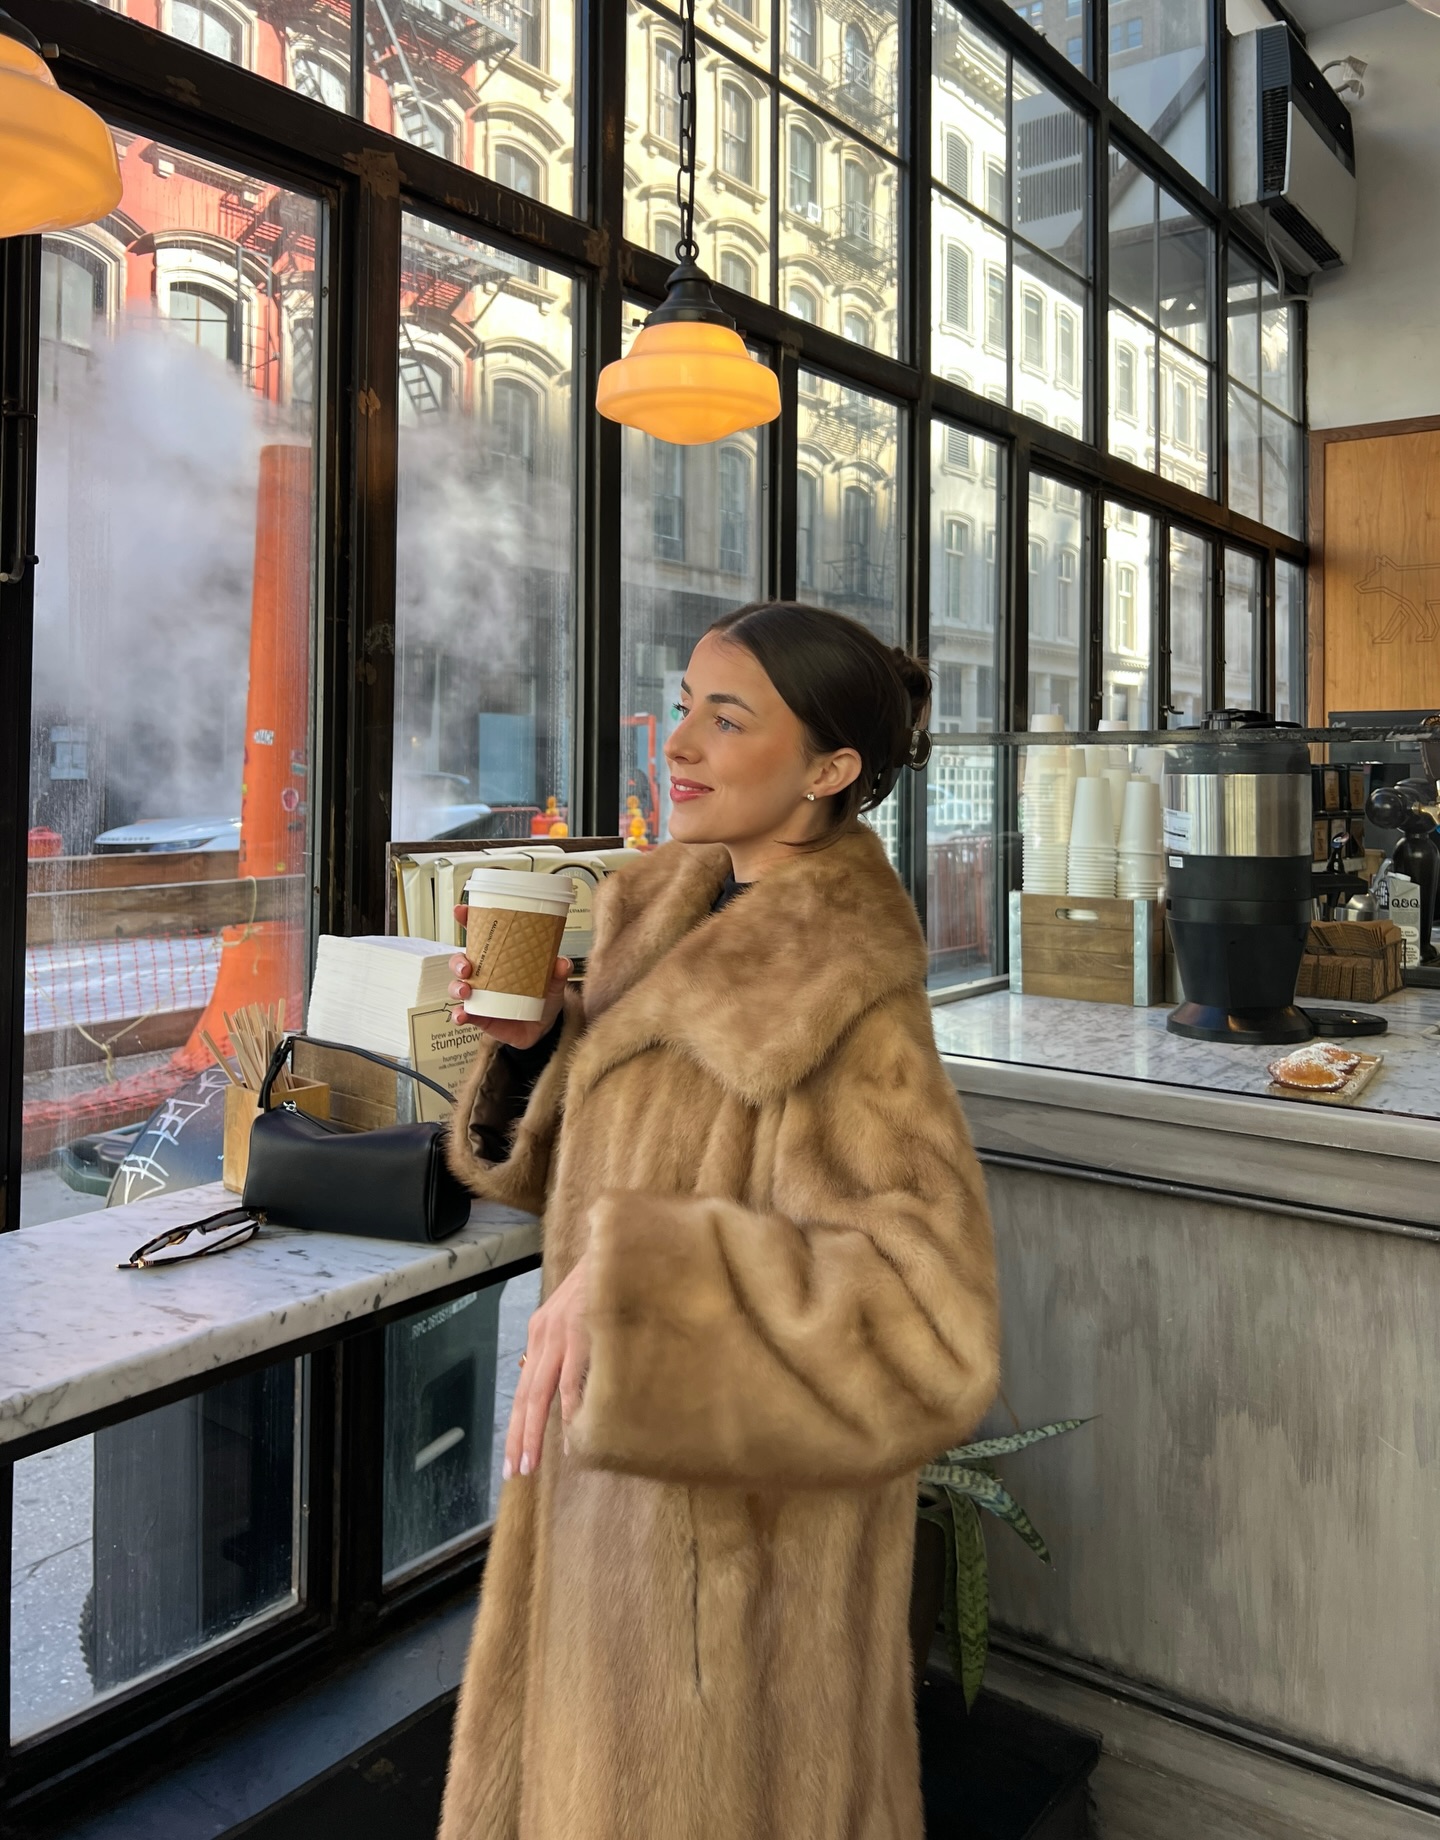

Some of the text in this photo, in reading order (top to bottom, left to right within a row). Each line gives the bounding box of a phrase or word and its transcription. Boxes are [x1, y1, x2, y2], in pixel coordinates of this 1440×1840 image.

[1391, 898, 1420, 909] Q&Q
[431, 1033, 447, 1041] brew
[454, 1026, 472, 1036] home
[442, 1053, 462, 1063] hungry
